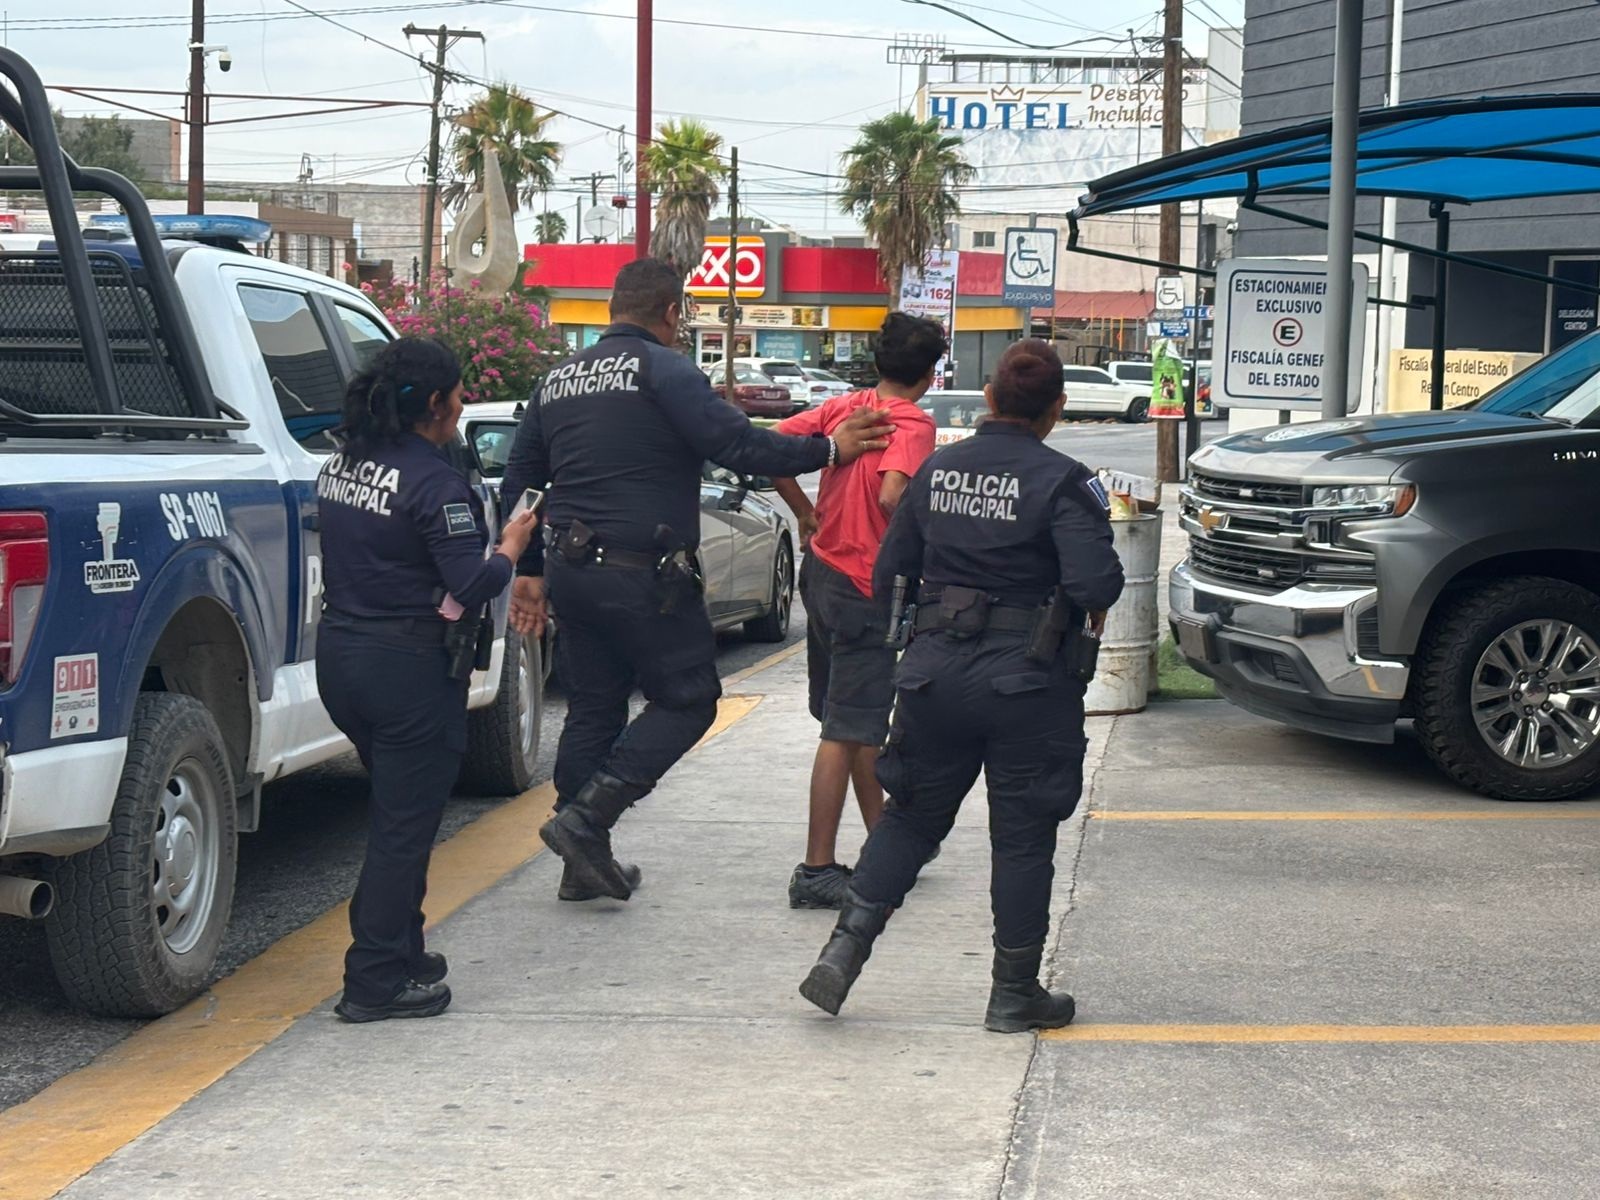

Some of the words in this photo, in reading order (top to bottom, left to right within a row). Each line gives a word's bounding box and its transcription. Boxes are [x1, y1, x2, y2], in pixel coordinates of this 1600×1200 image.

[930, 96, 1077, 129] HOTEL
[1256, 299, 1322, 314] EXCLUSIVO
[1280, 325, 1296, 340] E
[545, 352, 640, 386] POLICÍA
[1231, 348, 1284, 365] FISCALÍA
[1400, 355, 1429, 372] Fiscalía
[1463, 359, 1477, 375] del
[1477, 360, 1508, 377] Estado
[540, 371, 639, 406] MUNICIPAL
[1248, 372, 1271, 386] DEL
[1273, 373, 1320, 388] ESTADO
[1450, 381, 1480, 397] Centro
[317, 474, 392, 516] MUNICIPAL
[930, 469, 1020, 498] POLICÍA
[159, 490, 229, 541] SP-1061
[929, 490, 1017, 521] MUNICIPAL
[86, 562, 138, 582] FRONTERA
[59, 663, 93, 689] 911
